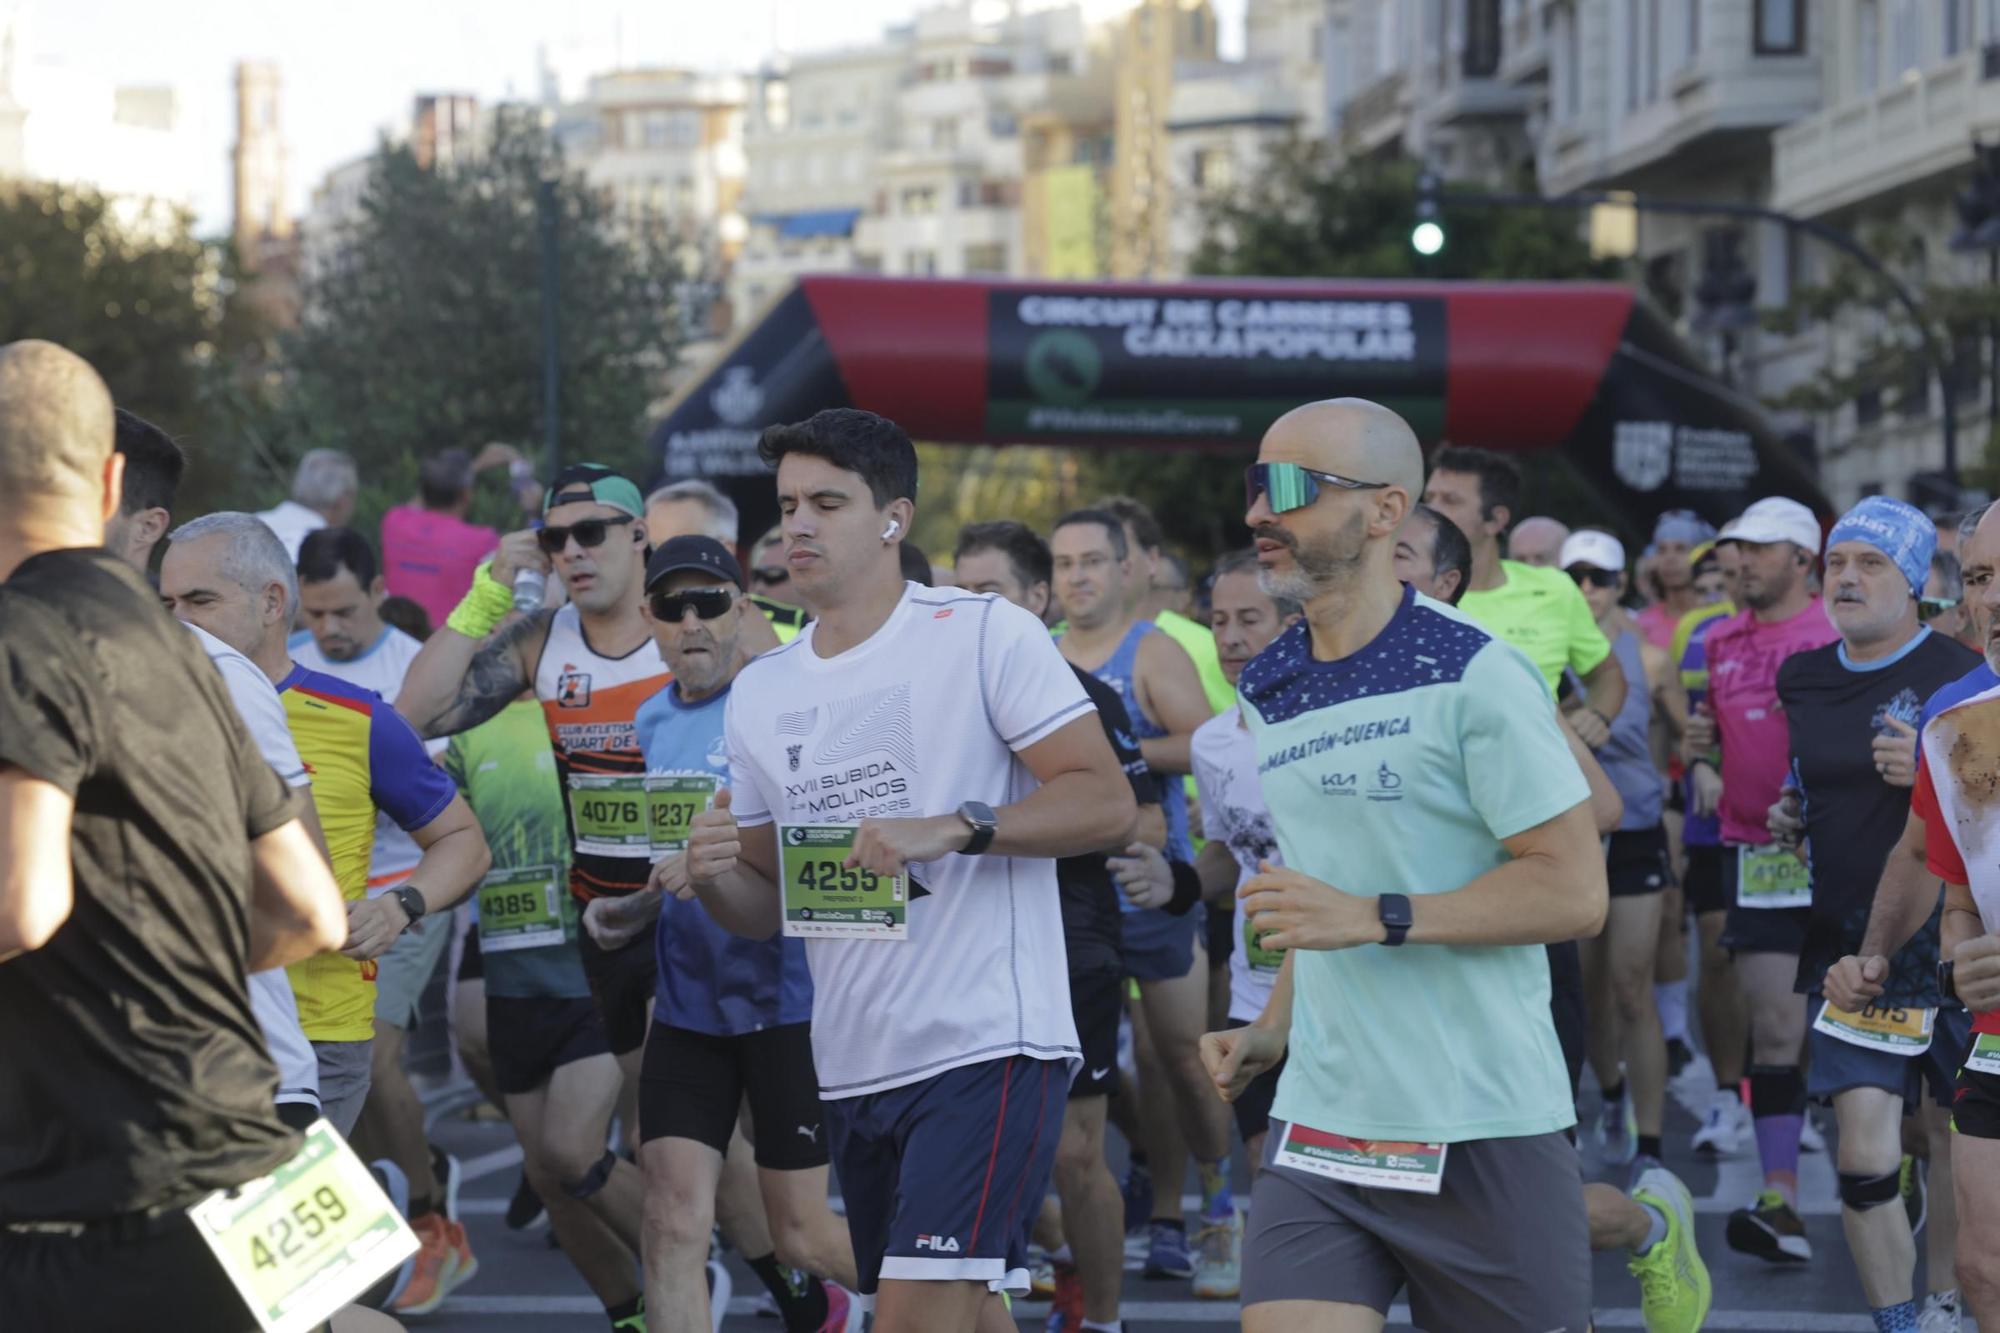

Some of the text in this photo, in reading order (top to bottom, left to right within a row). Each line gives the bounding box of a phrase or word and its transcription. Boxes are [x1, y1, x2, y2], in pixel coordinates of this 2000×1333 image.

[1018, 297, 1411, 328] CIRCUIT DE CARRERES
[612, 736, 632, 748] DE
[785, 760, 897, 799] XVII SUBIDA
[808, 777, 908, 814] MOLINOS
[582, 801, 639, 823] 4076
[798, 860, 879, 892] 4255
[483, 892, 537, 917] 4385
[250, 1186, 347, 1271] 4259
[916, 1234, 960, 1252] FILA
